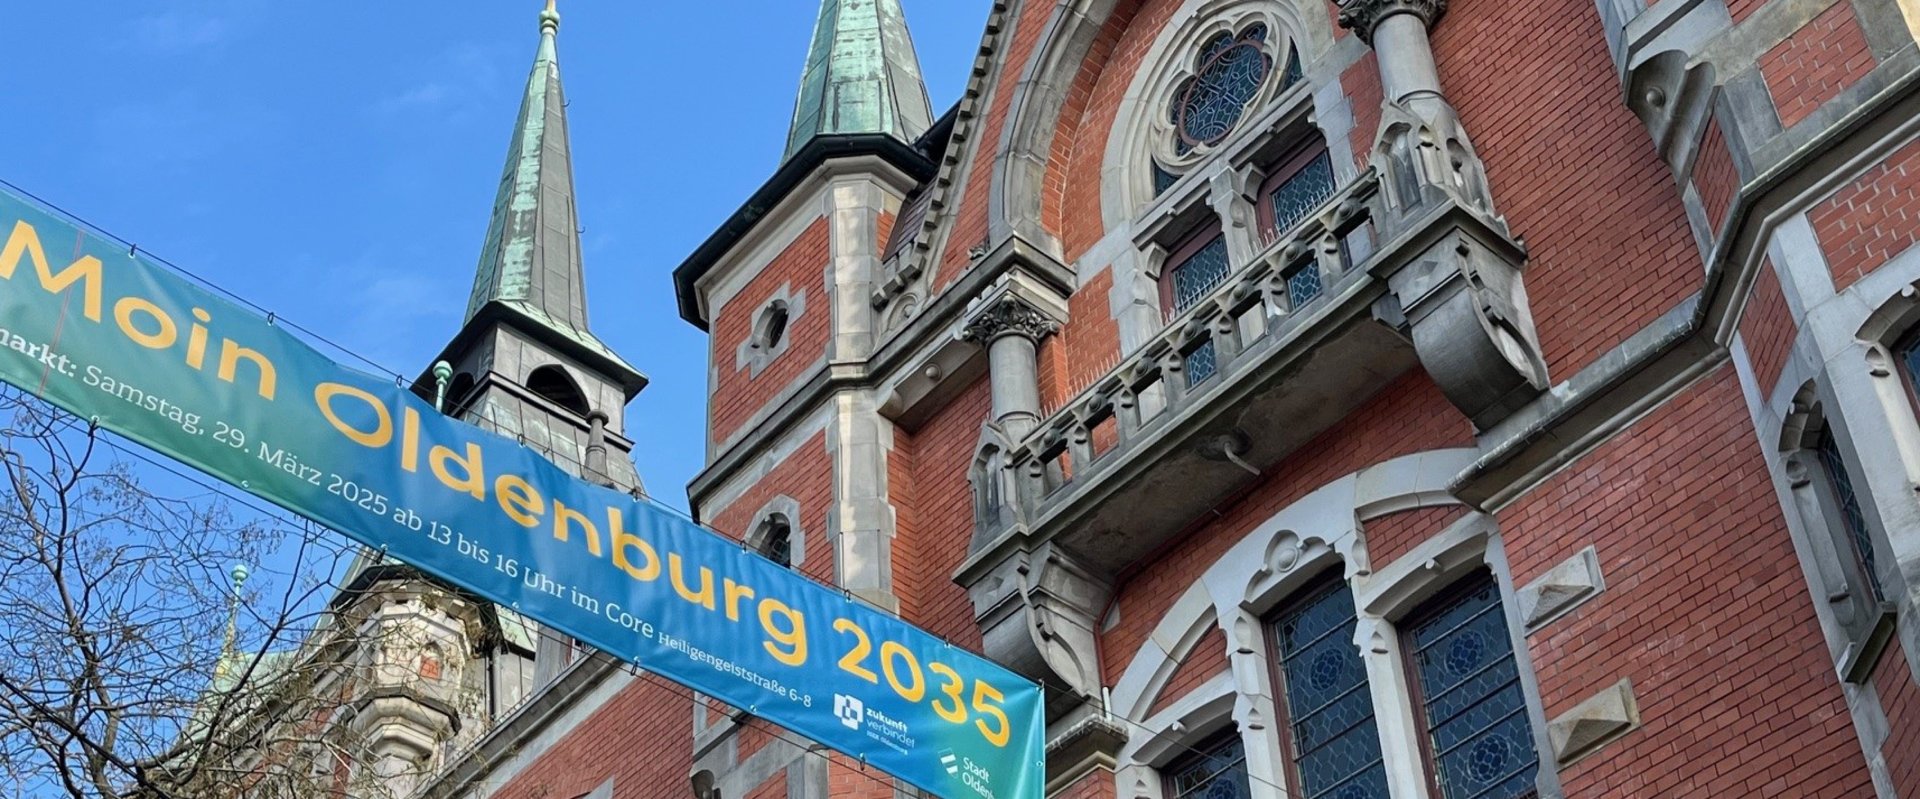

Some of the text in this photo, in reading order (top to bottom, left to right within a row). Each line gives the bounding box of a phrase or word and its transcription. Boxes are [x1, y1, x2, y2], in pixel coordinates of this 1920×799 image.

[0, 219, 1010, 747] Moin Oldenburg 2035
[83, 365, 205, 436] Samstag,
[213, 421, 250, 453] 29.
[258, 441, 322, 486] März
[327, 474, 388, 516] 2025
[394, 507, 422, 532] ab
[428, 520, 451, 545] 13
[457, 533, 490, 564] bis
[496, 555, 518, 577] 16
[524, 567, 566, 599] Uhr
[571, 586, 599, 615] im
[605, 603, 653, 638] Core
[658, 632, 786, 696] Heiligengeiststraße
[866, 708, 908, 733] zukunft
[963, 757, 990, 784] Stadt
